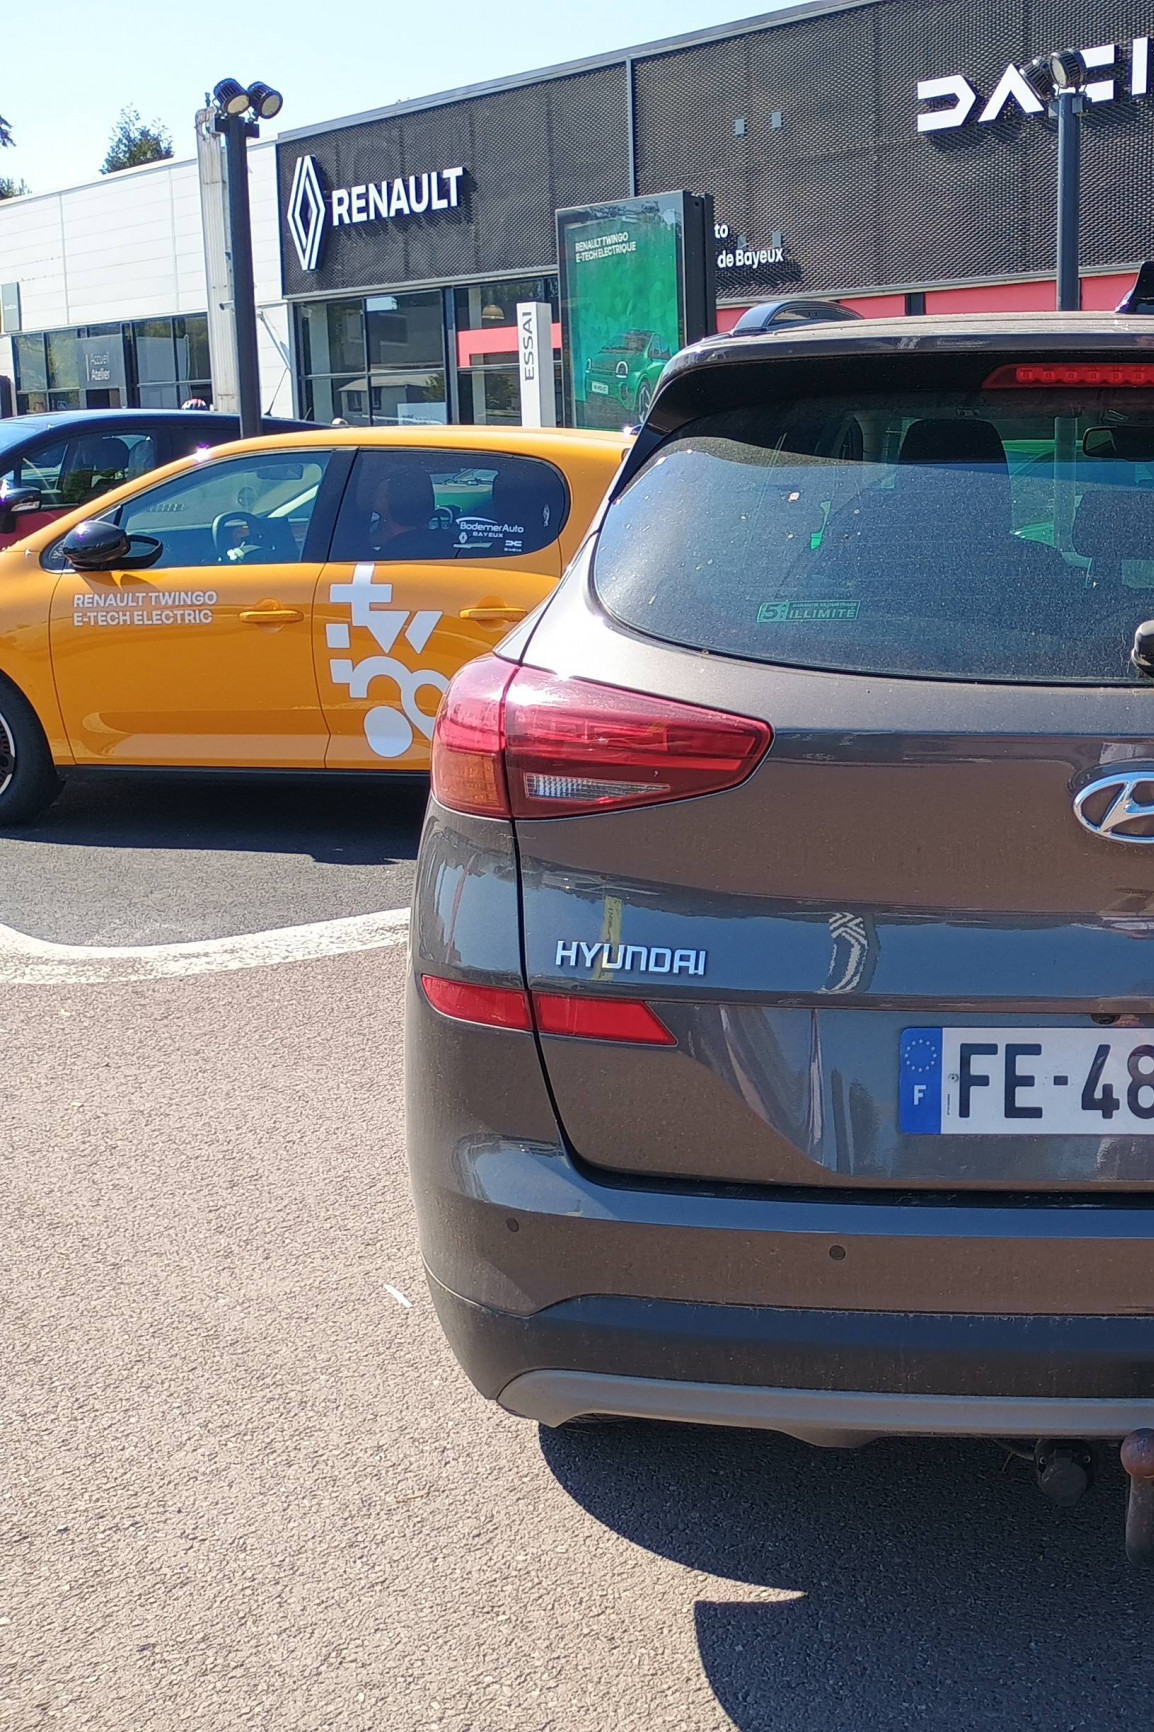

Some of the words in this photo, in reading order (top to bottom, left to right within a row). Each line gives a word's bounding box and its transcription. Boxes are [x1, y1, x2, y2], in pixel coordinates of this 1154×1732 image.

[331, 166, 464, 227] RENAULT
[575, 237, 602, 252] RENAULT
[602, 232, 629, 246] TWINGO
[575, 250, 598, 263] E-TECH
[717, 250, 735, 268] de
[735, 248, 784, 269] Bayeux
[522, 311, 535, 381] ESSAI
[73, 592, 146, 608] RENAULT
[148, 590, 217, 606] TWINGO
[73, 611, 131, 626] E-TECH
[133, 609, 213, 625] ELECTRIC
[789, 607, 856, 619] ILLIMITÉ
[555, 940, 707, 976] HYUNDAI
[913, 1084, 927, 1105] F
